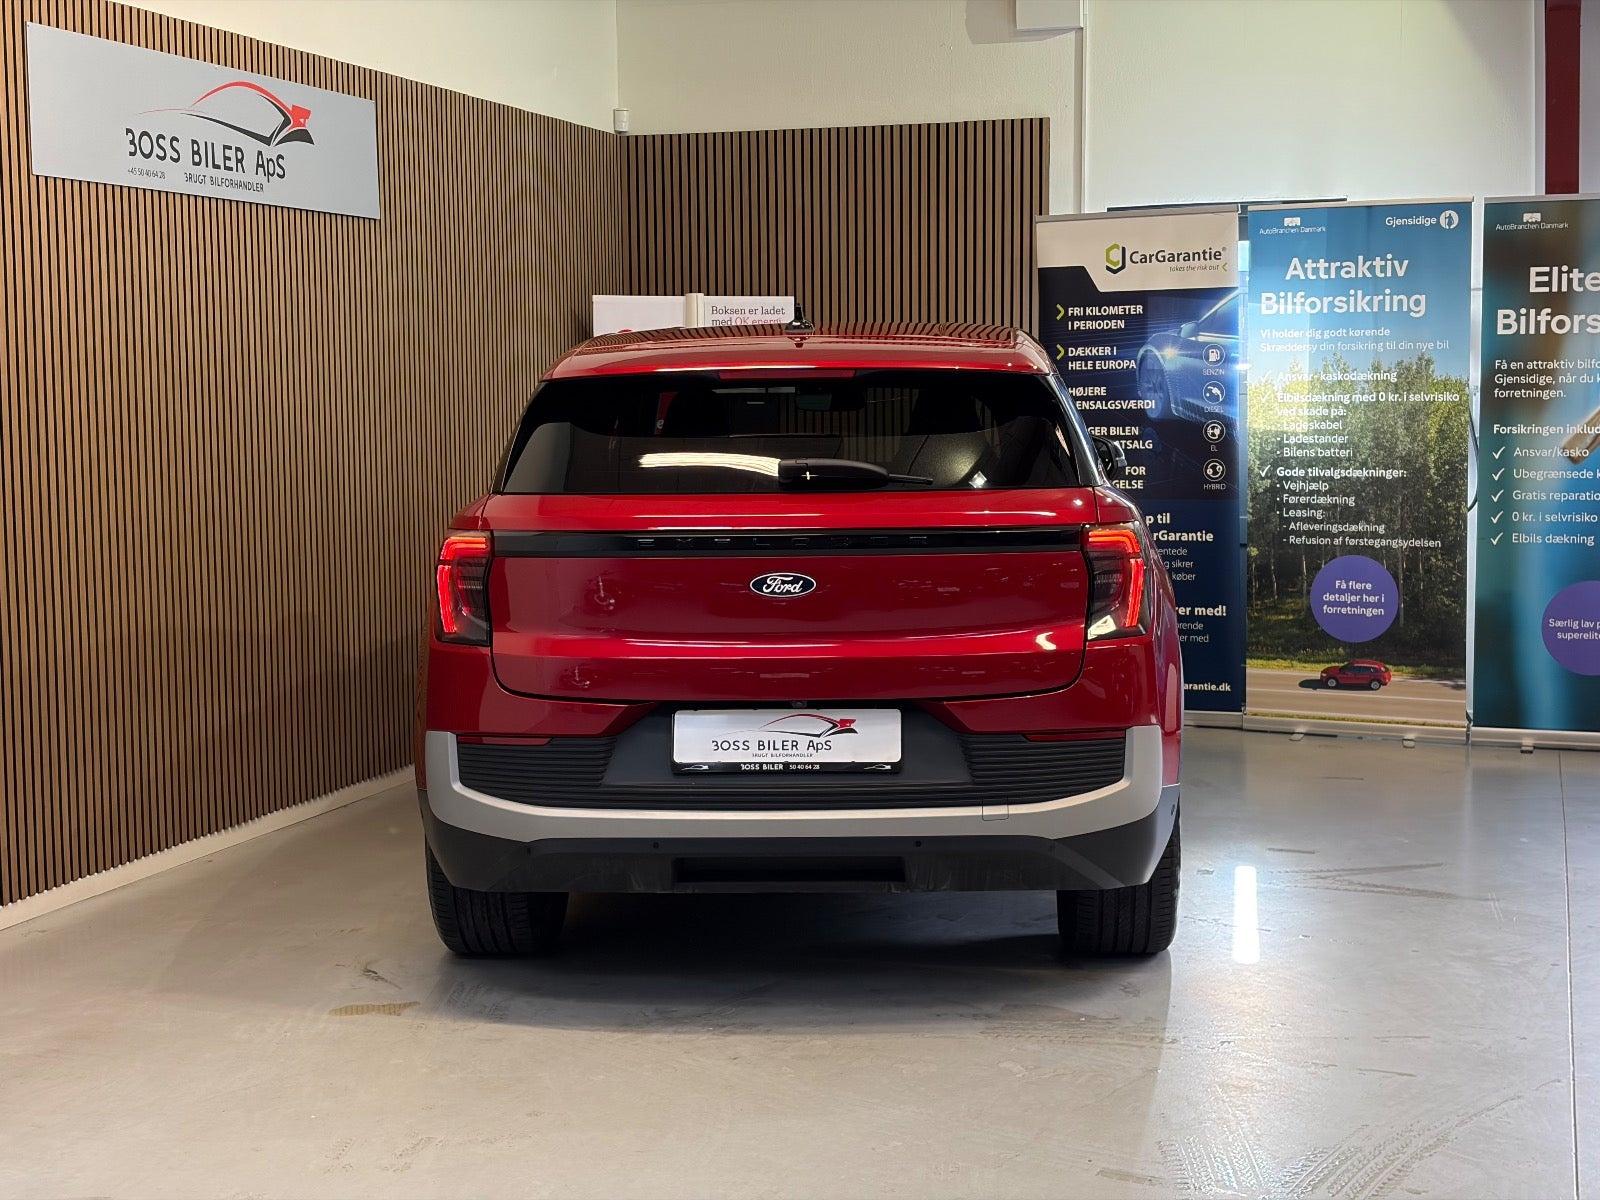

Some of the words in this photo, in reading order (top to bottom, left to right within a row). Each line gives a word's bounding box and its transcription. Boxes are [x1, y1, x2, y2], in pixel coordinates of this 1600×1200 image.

[191, 138, 245, 174] BILER
[256, 150, 286, 183] ApS
[210, 176, 264, 192] BILFORHANDLER
[1385, 215, 1436, 227] Gjensidige
[1540, 221, 1568, 229] Danmark
[1285, 253, 1409, 280] Attraktiv
[1529, 265, 1600, 293] Elite
[1260, 288, 1426, 318] Bilforsikring
[712, 306, 746, 315] Boksen
[761, 306, 786, 315] ladet
[1068, 307, 1083, 317] FRI
[1086, 304, 1143, 316] KILOMETER
[712, 317, 732, 326] med
[735, 317, 750, 325] OK
[1074, 320, 1125, 330] PERIODEN
[1260, 330, 1270, 338] Vi
[1272, 329, 1304, 338] holder
[1306, 328, 1321, 339] dig
[1324, 328, 1346, 339] godt
[1349, 327, 1390, 337] kørende
[1320, 342, 1334, 350] din
[1337, 341, 1384, 352] forsikring
[1386, 341, 1396, 350] til
[1398, 340, 1414, 350] din
[1416, 342, 1434, 352] nye
[1436, 340, 1449, 349] bil
[1068, 347, 1111, 357] DÆKKER
[1068, 361, 1093, 370] HELE
[1096, 359, 1136, 370] EUROPA
[1495, 360, 1507, 370] Få
[1510, 362, 1523, 370] en
[1526, 359, 1574, 369] attraktiv
[1320, 371, 1398, 382] kaskodækning
[1494, 374, 1555, 386] Gjensidige,
[1559, 372, 1576, 383] når
[1580, 373, 1594, 383] du
[1068, 387, 1107, 396] HØJERE
[1494, 388, 1566, 400] forretningen.
[1277, 392, 1350, 404] Elbilsdækning
[1352, 392, 1376, 401] med
[1378, 392, 1386, 401] 0
[1388, 392, 1402, 401] kr.
[1409, 392, 1460, 401] selvrisiko
[1076, 400, 1155, 410] ENSALGSVÆRDI
[1277, 407, 1296, 416] ved
[1299, 407, 1328, 416] skade
[1331, 406, 1347, 418] på:
[1284, 420, 1342, 430] Ladeskabel
[1493, 424, 1563, 436] Forsikringen
[1110, 427, 1138, 435] BILEN
[1284, 434, 1348, 443] Ladestander
[1284, 447, 1315, 457] Bilens
[1318, 447, 1353, 457] batteri
[1514, 446, 1589, 458] Ansvar/kasko
[1125, 466, 1146, 475] FOR
[1276, 468, 1305, 478] Gode
[1307, 467, 1407, 479] tilvalgsdækninger:
[1514, 468, 1594, 481] Ubegrænsede
[1112, 480, 1144, 489] GELSE
[1283, 480, 1328, 491] Vejhjælp
[1283, 495, 1355, 506] Førerdækning
[1512, 490, 1546, 500] Gratis
[1157, 513, 1171, 524] til
[1283, 508, 1326, 518] Leasing:
[1512, 512, 1519, 522] 0
[1522, 512, 1535, 522] kr.
[1545, 512, 1598, 522] selvrisiko
[1289, 523, 1385, 534] Afleveringsdækning
[1154, 530, 1214, 541] rGarantie
[1512, 533, 1542, 543] Elbils
[1545, 534, 1594, 546] dækning
[1289, 536, 1331, 545] Refusion
[1334, 536, 1343, 545] af
[1345, 537, 1441, 548] førstegangsydelsen
[1172, 559, 1194, 568] sikrer
[1172, 572, 1196, 580] køber
[762, 576, 802, 593] Ford
[1335, 580, 1347, 589] Få
[1349, 580, 1372, 590] flere
[1323, 592, 1360, 603] detaljer
[1362, 594, 1379, 602] her
[1194, 605, 1226, 616] med!
[1323, 605, 1384, 616] forretningen
[1549, 618, 1579, 629] Særlig
[1582, 619, 1594, 628] lav
[1190, 634, 1209, 642] med
[1557, 631, 1600, 640] superelit
[758, 740, 799, 750] BILER
[807, 740, 832, 752] ApS
